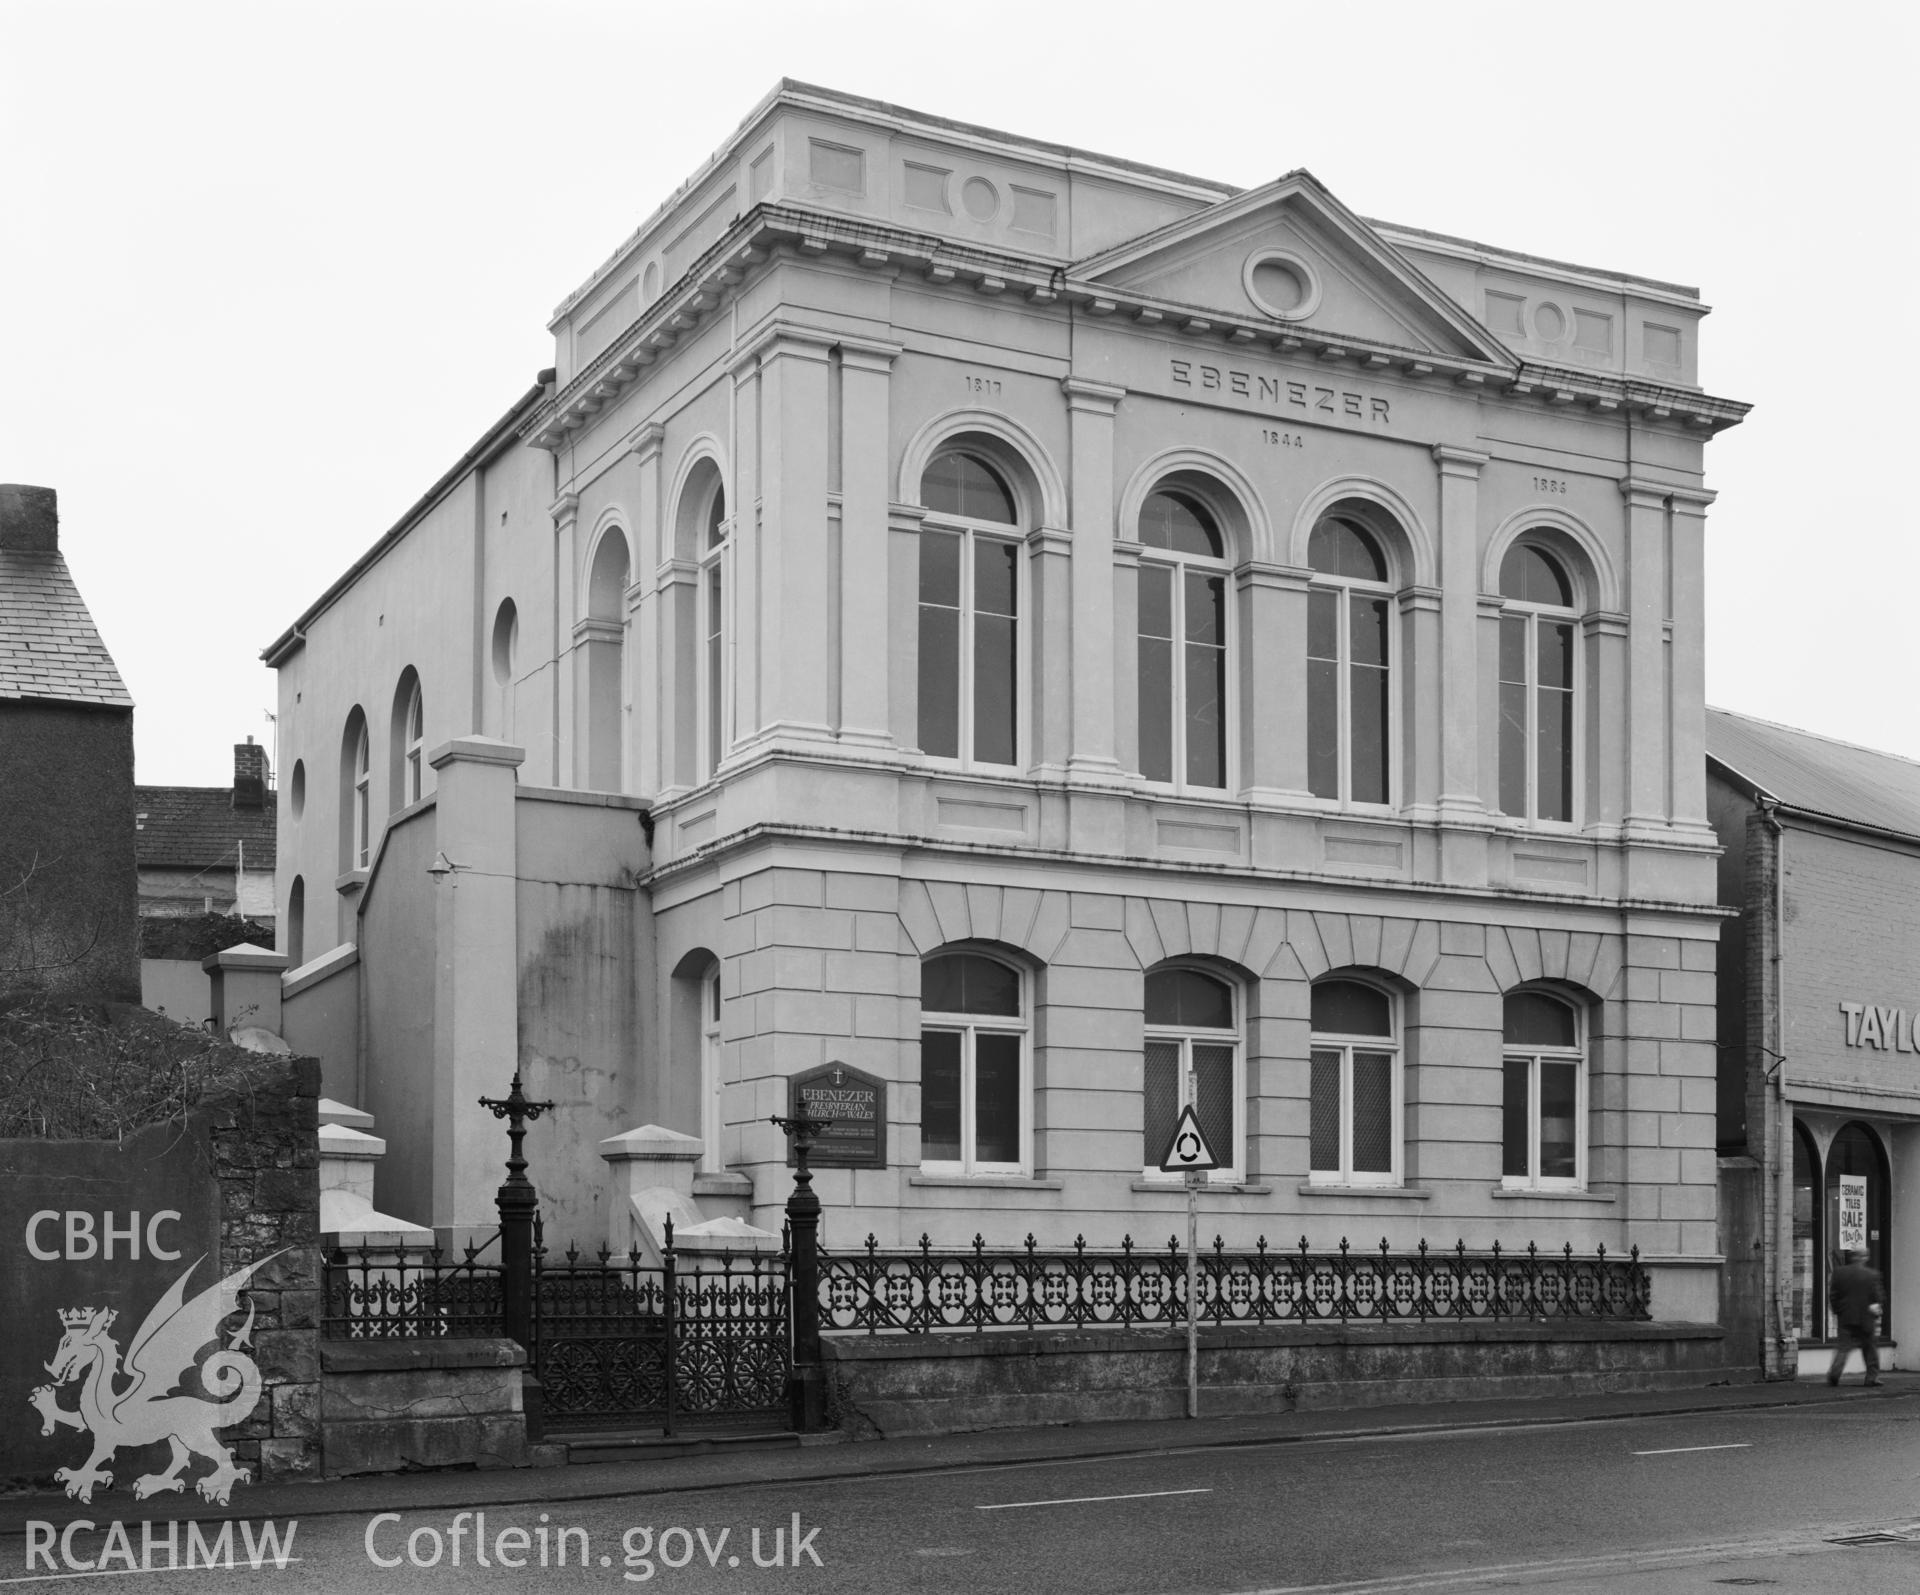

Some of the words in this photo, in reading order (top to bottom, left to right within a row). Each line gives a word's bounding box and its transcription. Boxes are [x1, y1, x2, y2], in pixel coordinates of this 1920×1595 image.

[965, 376, 1002, 396] 1817
[1171, 360, 1390, 424] EBENEZER
[1262, 429, 1303, 449] 1844
[802, 1089, 874, 1102] EBENEZER
[810, 1101, 866, 1111] PRESBYTERIAN
[807, 1109, 839, 1118] HURCH
[847, 1111, 874, 1119] WALES
[1841, 1184, 1865, 1197] CERAMIC
[1845, 1198, 1861, 1210] TILES
[1841, 1210, 1863, 1228] SALE
